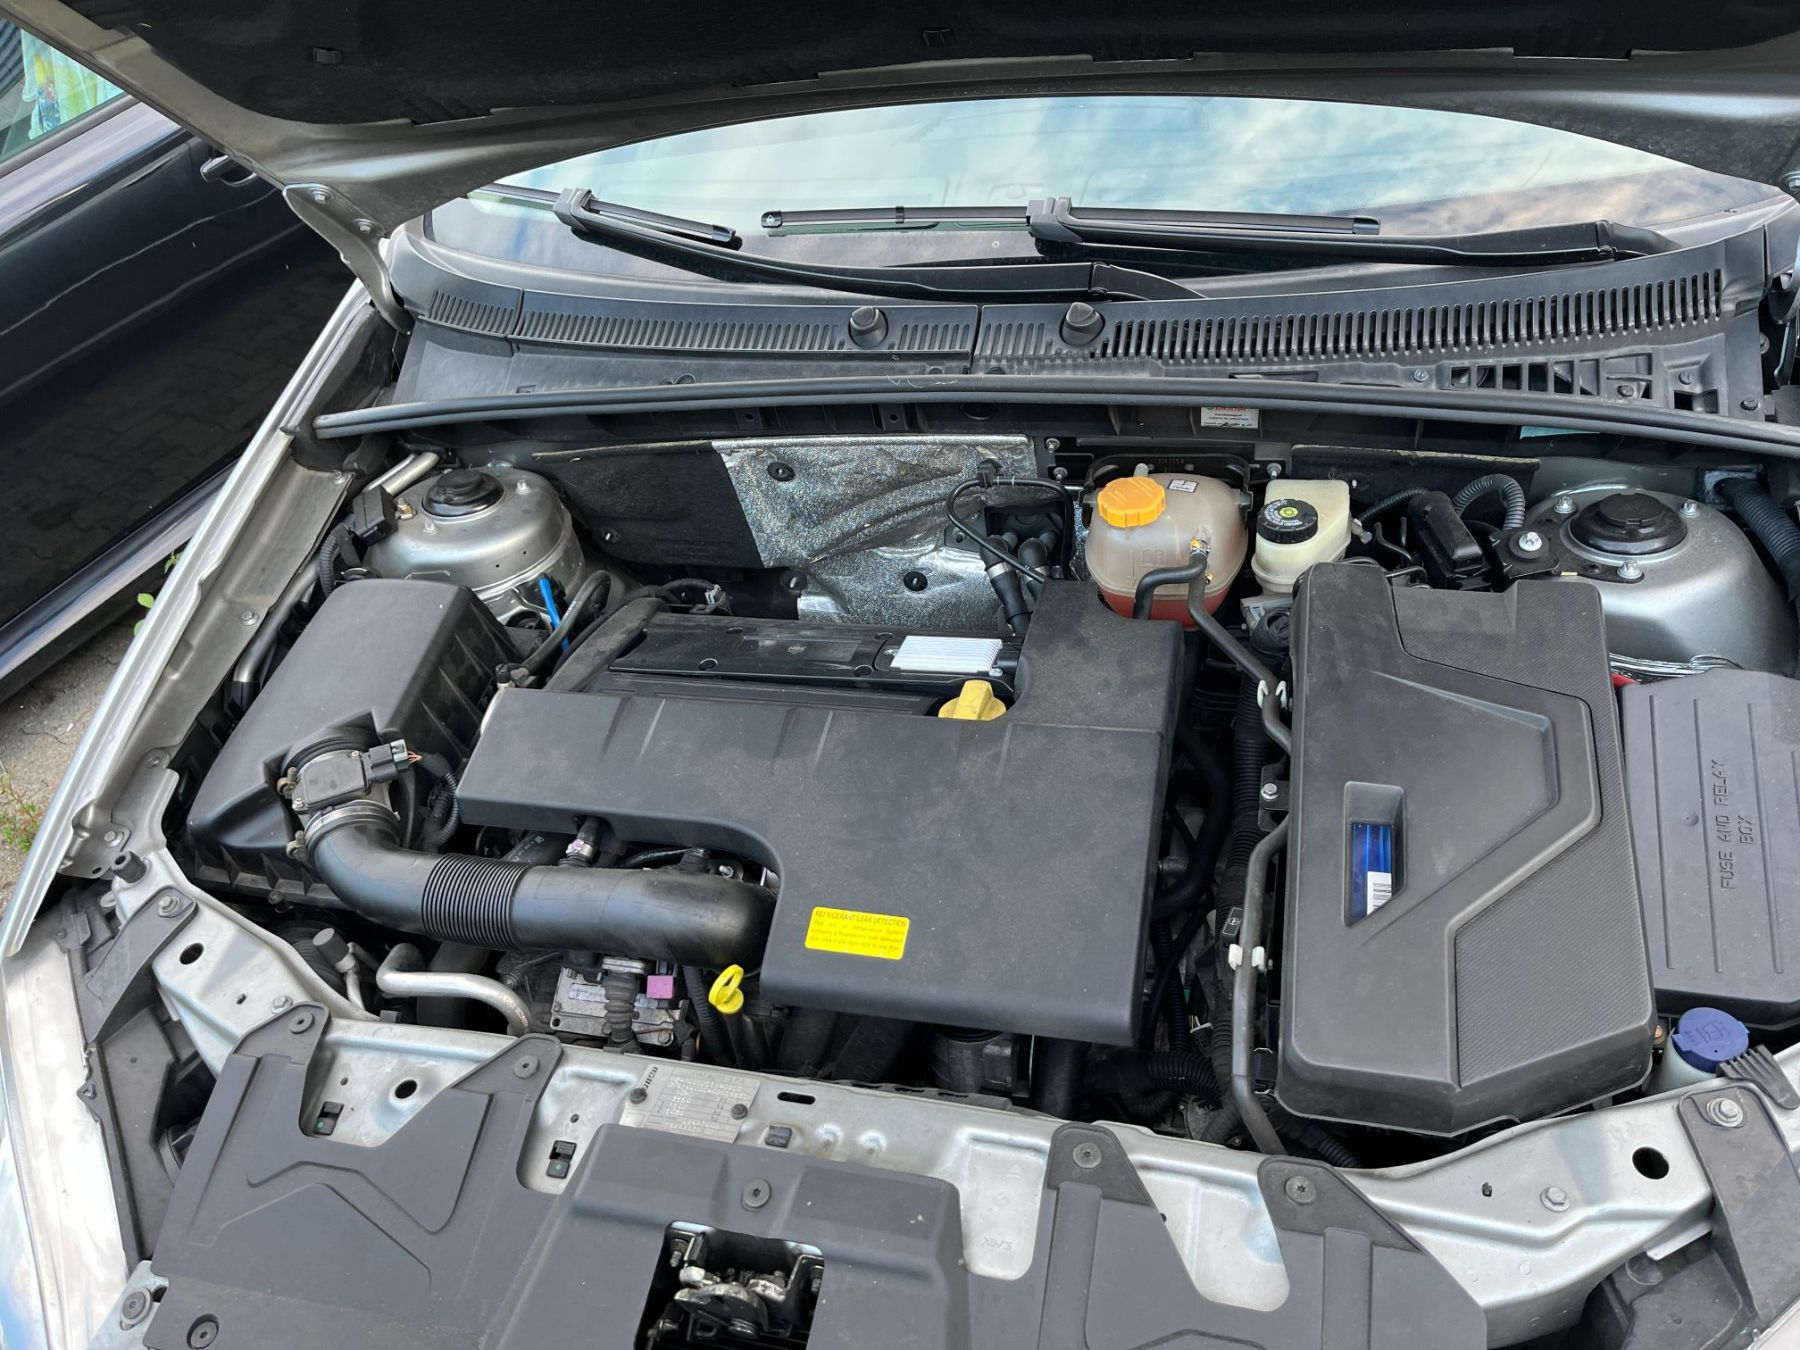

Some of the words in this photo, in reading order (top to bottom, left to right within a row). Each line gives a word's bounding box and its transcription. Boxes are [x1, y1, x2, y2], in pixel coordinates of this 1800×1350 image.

[1711, 759, 1729, 807] RELAY
[1715, 815, 1732, 843] AND
[1737, 815, 1754, 845] BOX
[1718, 850, 1736, 890] FUSE
[815, 910, 855, 921] REFRIGERANT
[857, 914, 872, 923] LEAK
[872, 916, 906, 927] DETECTION
